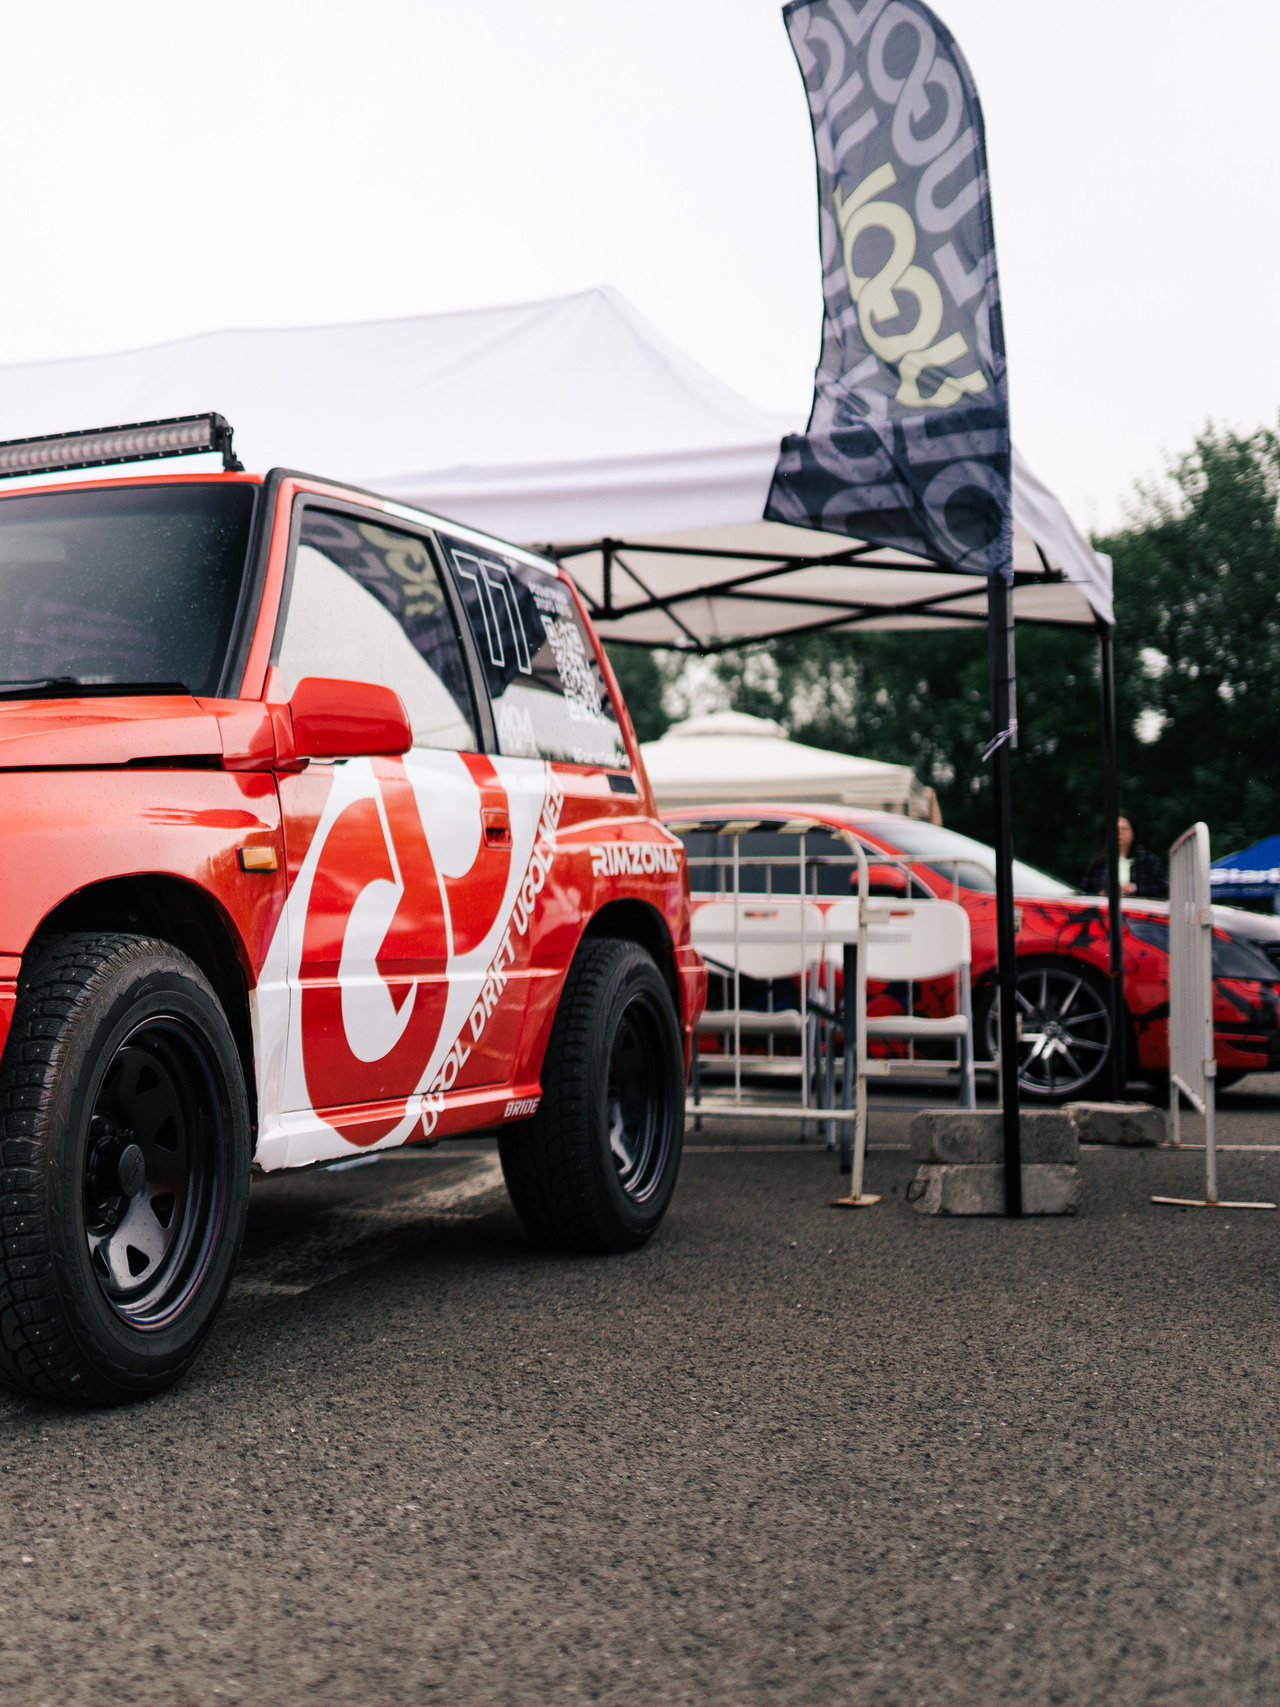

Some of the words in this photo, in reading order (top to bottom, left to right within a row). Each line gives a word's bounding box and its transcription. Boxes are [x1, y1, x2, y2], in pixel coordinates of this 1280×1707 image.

[589, 845, 679, 877] RIMZONA
[469, 926, 516, 1043] DRIFT
[512, 845, 554, 937] UGOL
[503, 1097, 541, 1118] BRIDE
